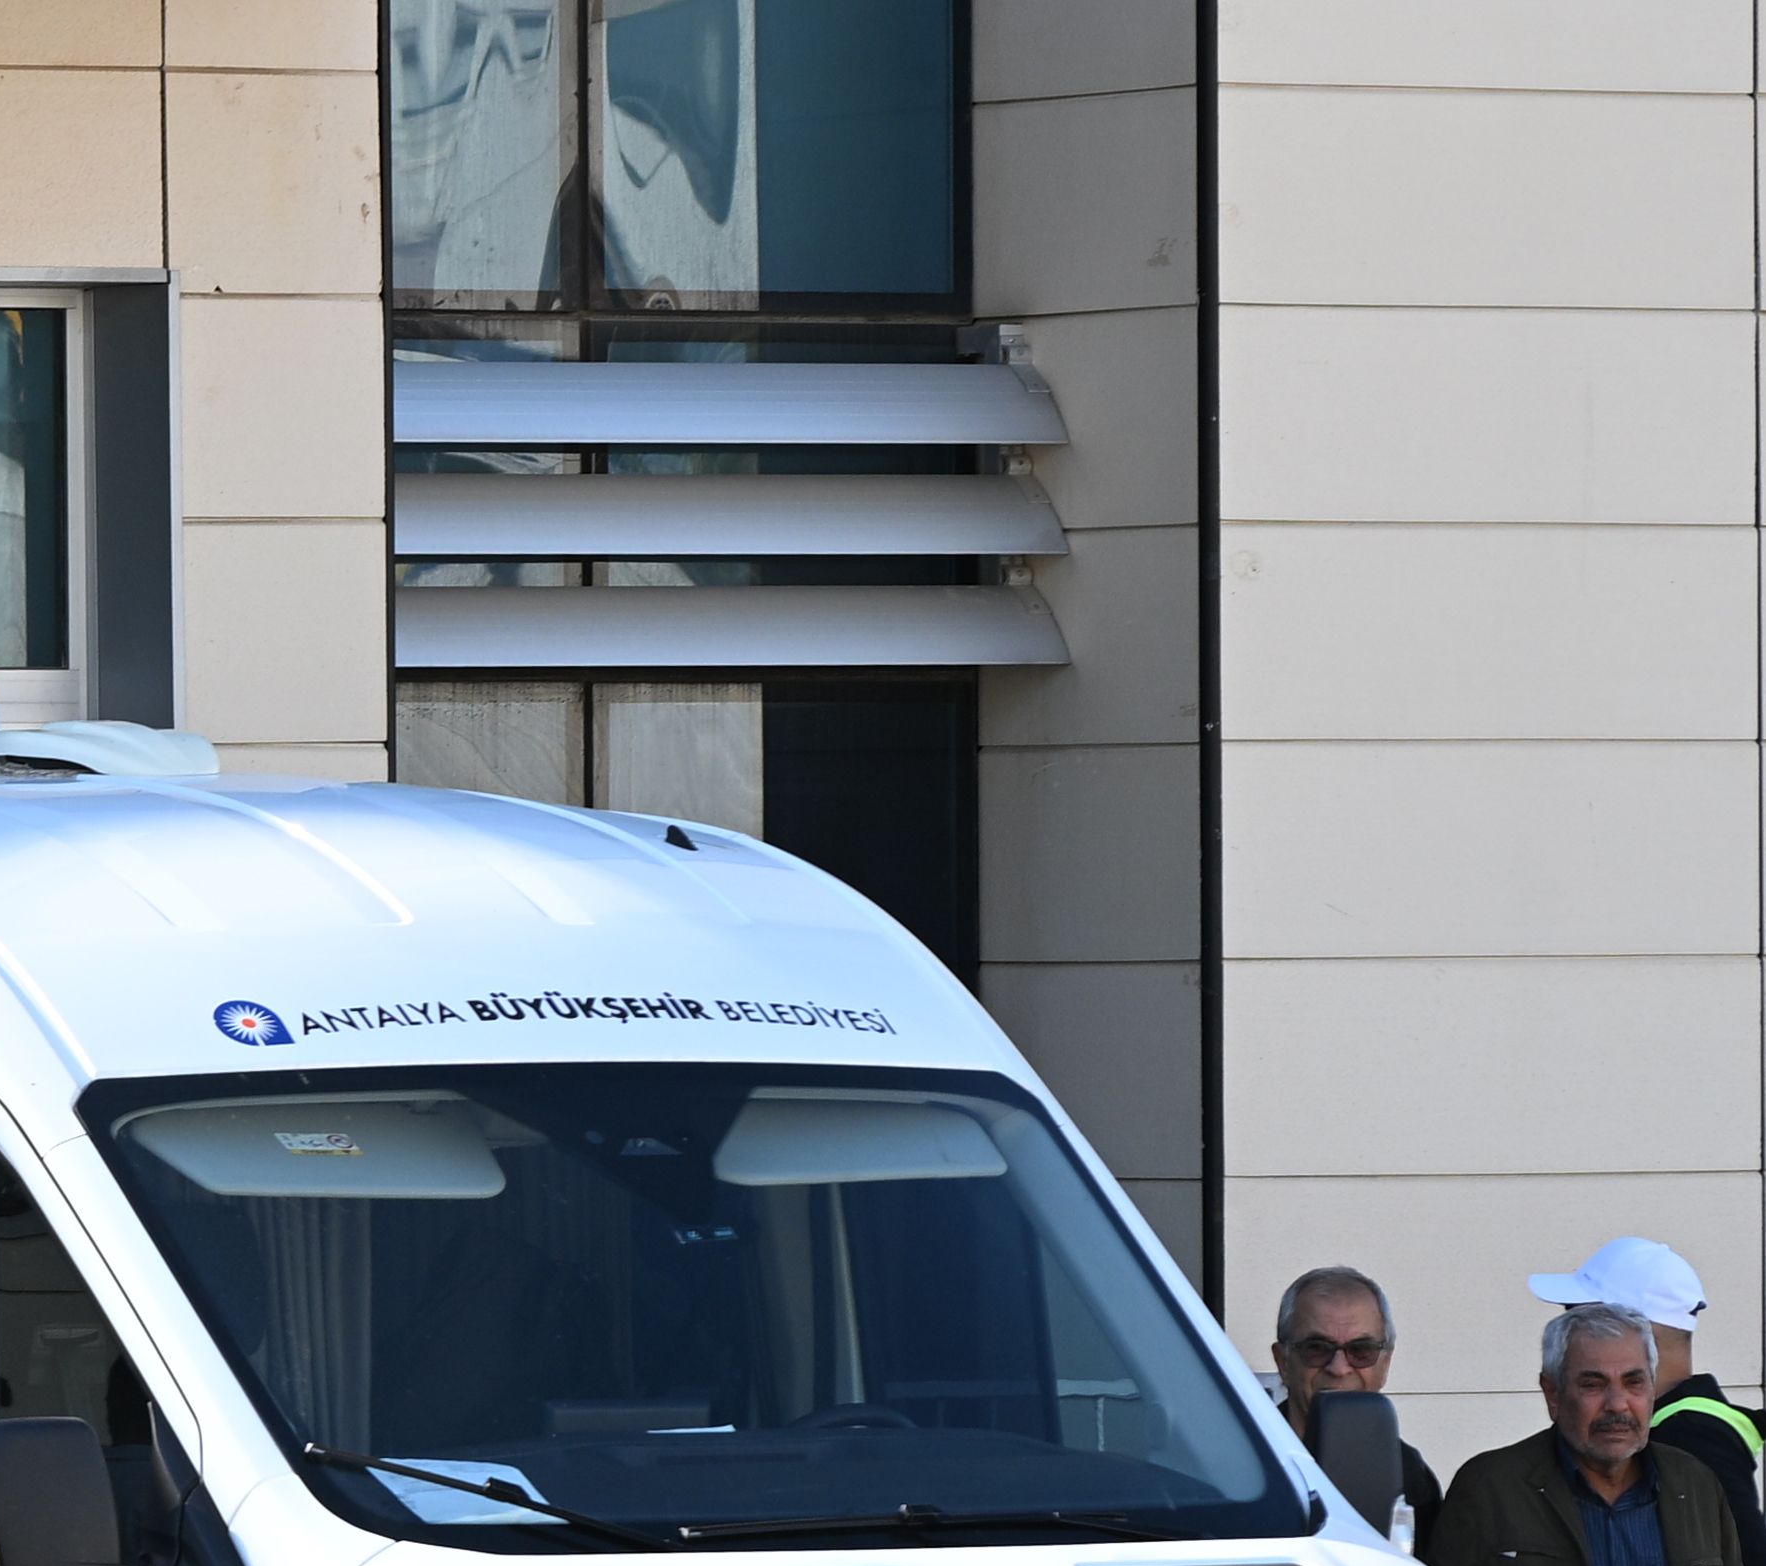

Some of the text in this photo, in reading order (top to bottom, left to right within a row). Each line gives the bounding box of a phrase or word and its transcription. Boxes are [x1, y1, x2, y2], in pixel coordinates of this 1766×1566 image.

[300, 991, 898, 1037] ANTALYA BÜYÜKŞEHİR BELEDİYESİ
